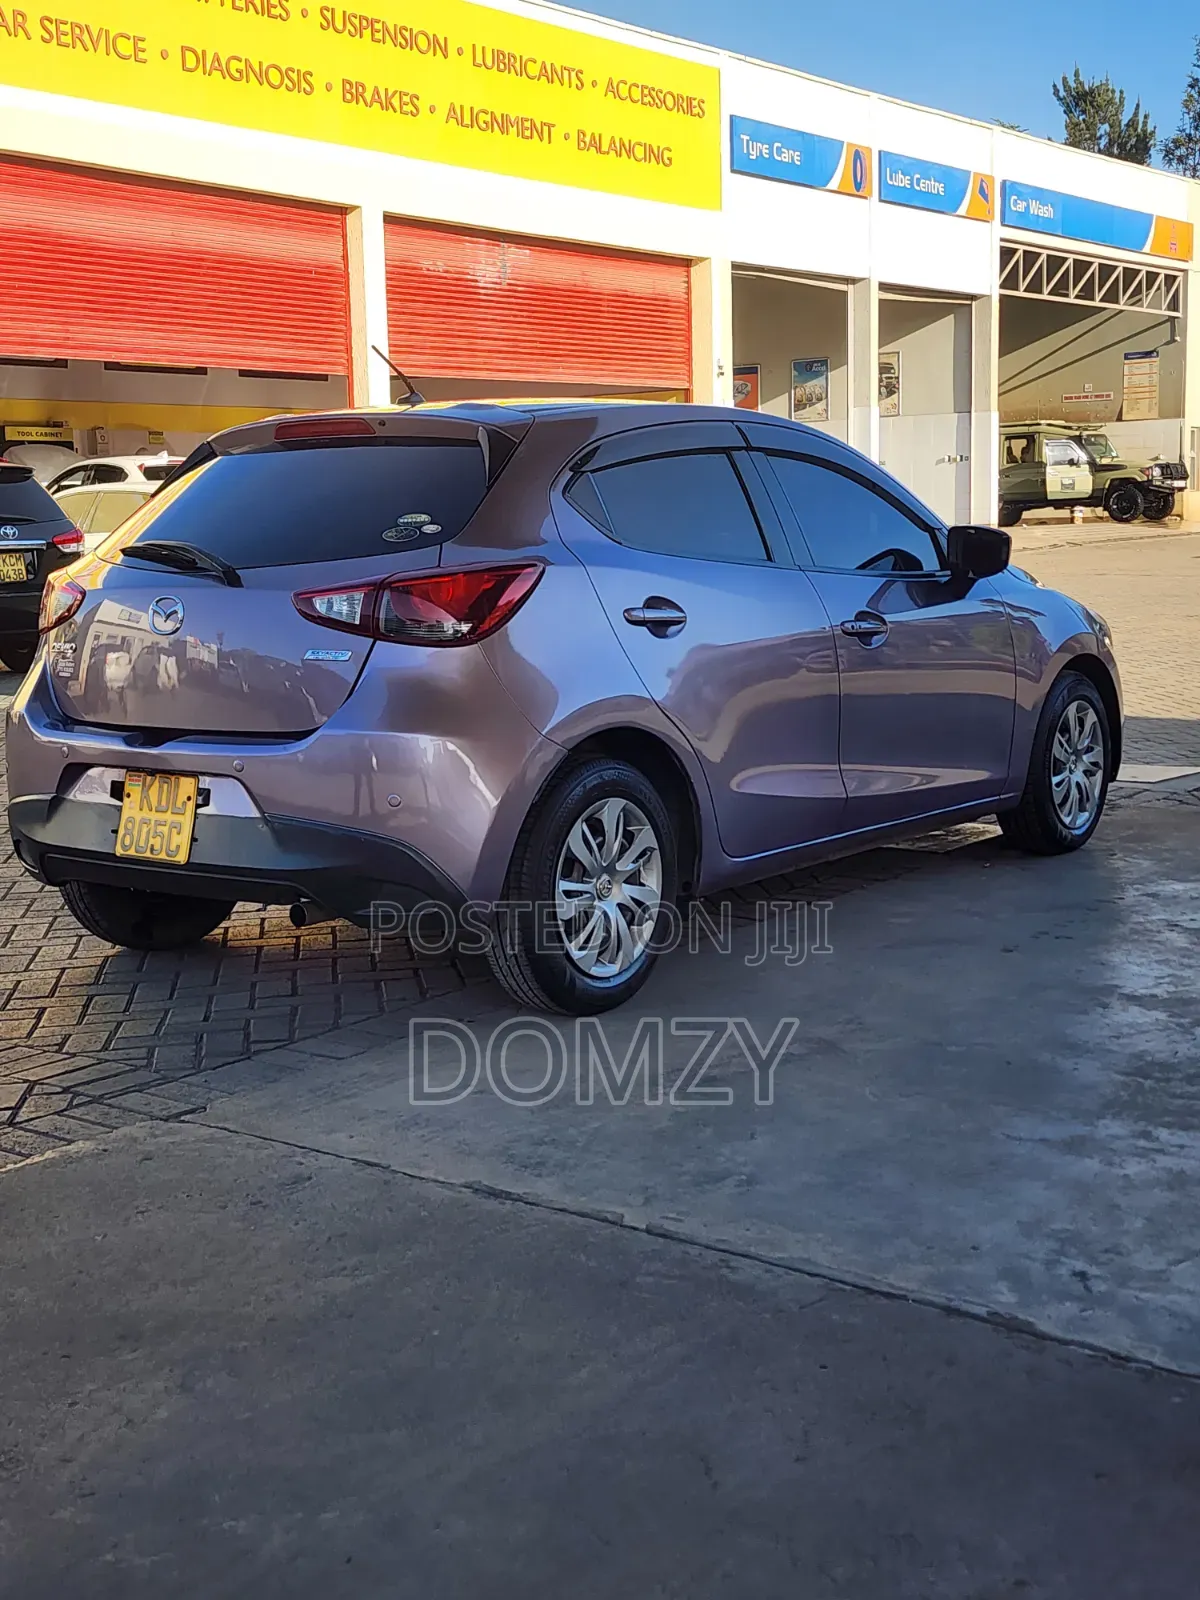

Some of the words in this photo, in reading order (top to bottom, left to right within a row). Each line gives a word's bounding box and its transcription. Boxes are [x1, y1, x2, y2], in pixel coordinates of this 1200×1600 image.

[319, 6, 448, 59] SUSPENSION
[472, 44, 584, 91] LUBRICANTS
[604, 77, 706, 118] ACCESSORIES
[40, 16, 147, 63] SERVICE
[181, 45, 314, 95] DIAGNOSIS
[342, 78, 420, 117] BRAKES
[446, 103, 556, 144] ALIGNMENT
[577, 129, 673, 167] BALANCING
[740, 134, 769, 160] Tyre
[773, 142, 801, 165] Care
[886, 167, 910, 188] Lube
[913, 173, 945, 196] Centre
[1010, 195, 1027, 212] Car
[1029, 200, 1054, 219] Wash
[1, 554, 23, 567] KCM
[139, 774, 187, 815] KDL
[120, 816, 182, 858] 805C
